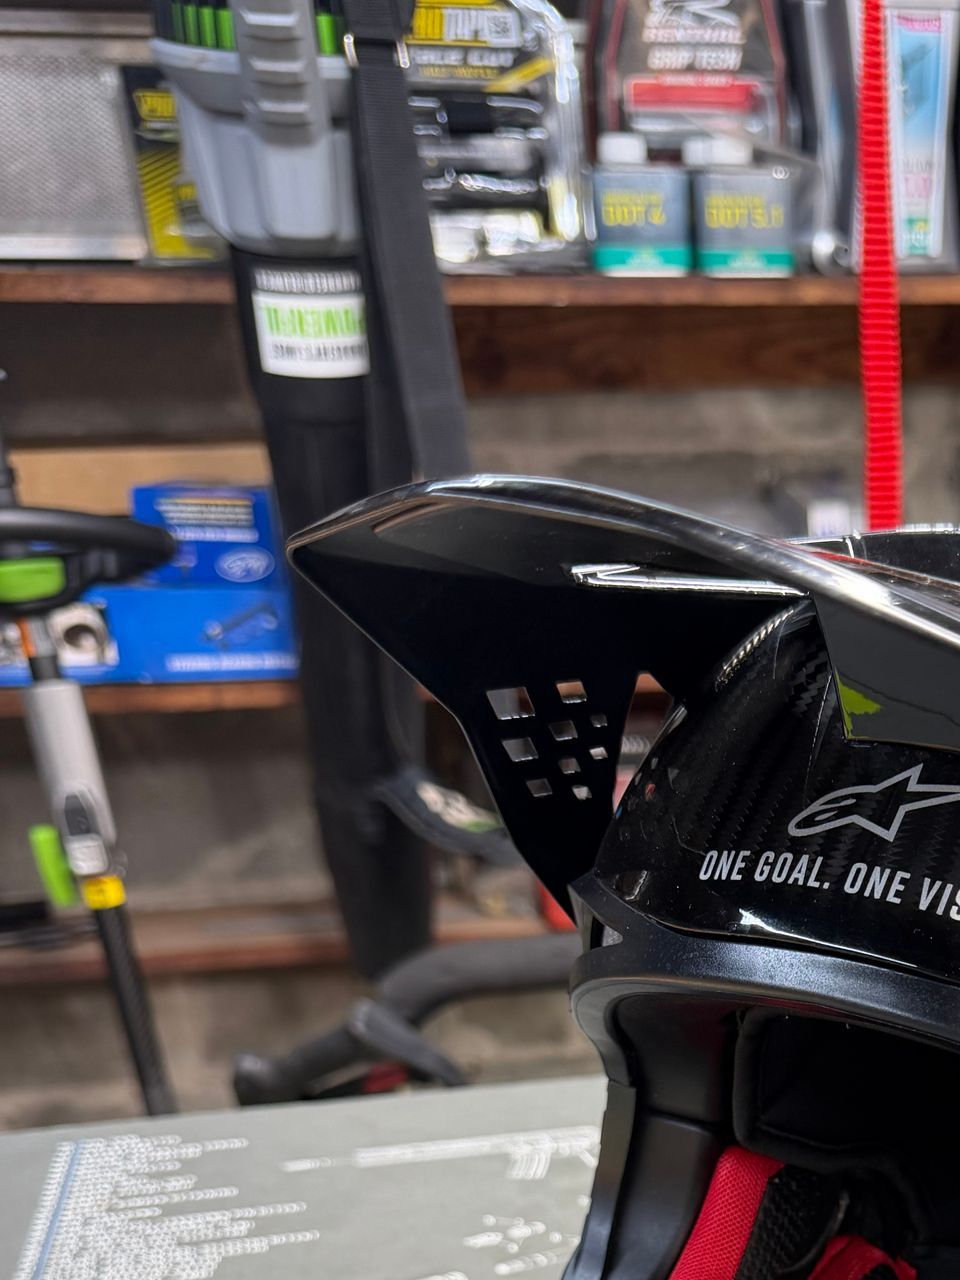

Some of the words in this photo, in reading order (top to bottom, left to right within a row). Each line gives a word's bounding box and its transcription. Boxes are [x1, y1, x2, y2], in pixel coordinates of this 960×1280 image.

[699, 850, 750, 880] ONE
[754, 851, 830, 889] GOAL.
[844, 862, 911, 904] ONE
